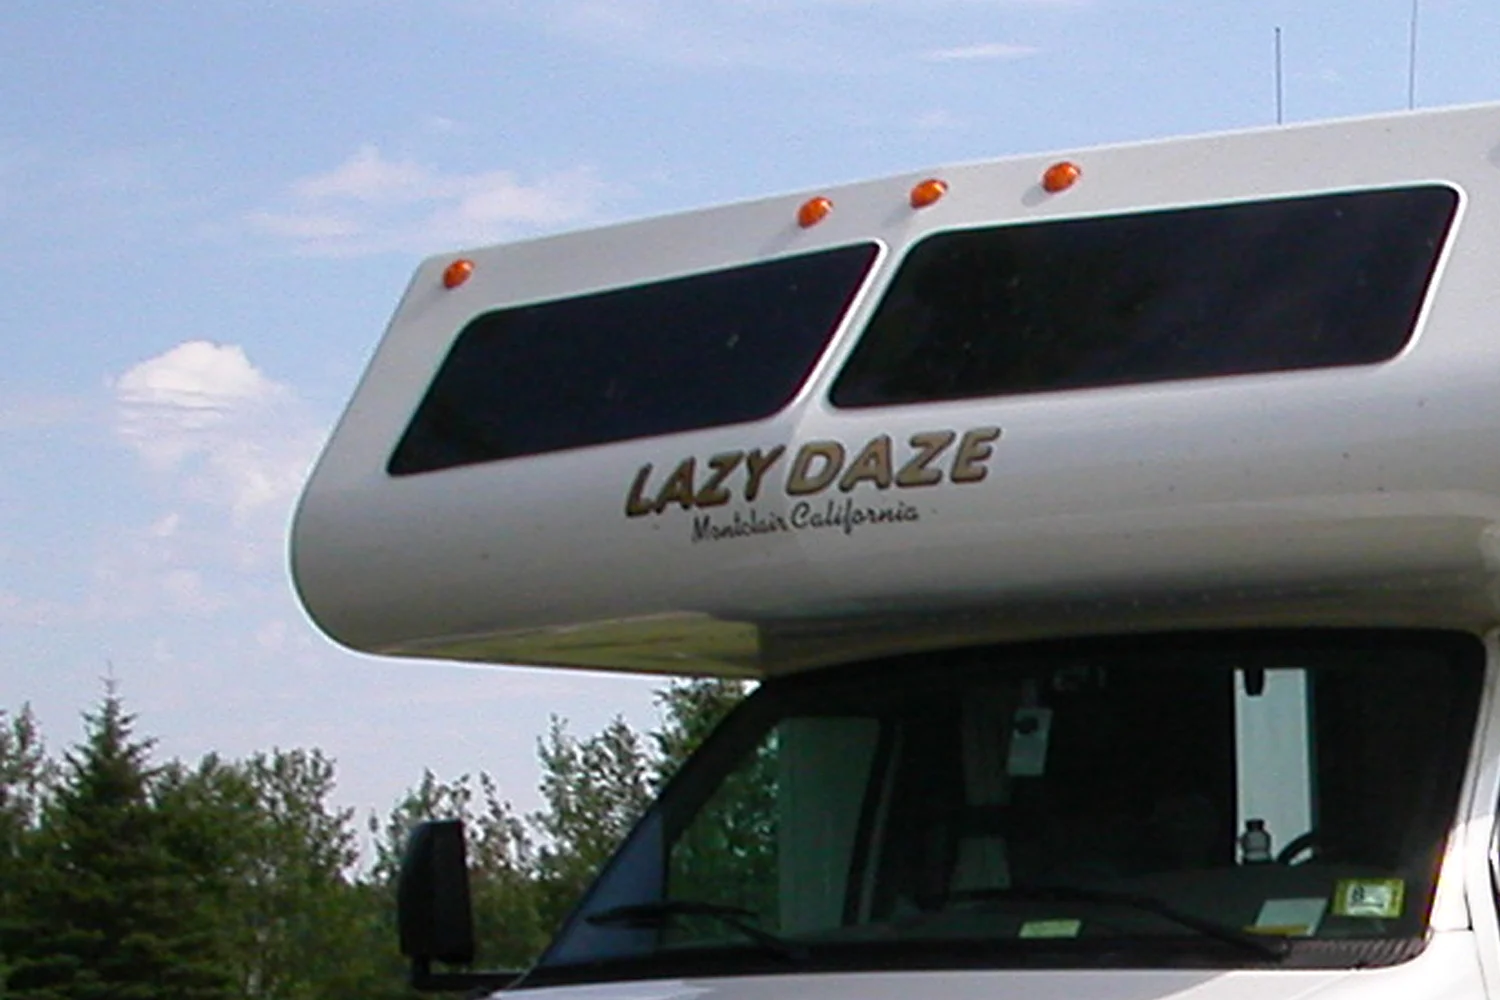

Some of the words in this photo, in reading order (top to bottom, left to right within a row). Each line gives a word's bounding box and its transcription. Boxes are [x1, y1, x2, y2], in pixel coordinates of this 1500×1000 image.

[625, 444, 786, 518] LAZY
[784, 426, 1001, 497] DAZE
[790, 500, 920, 536] California
